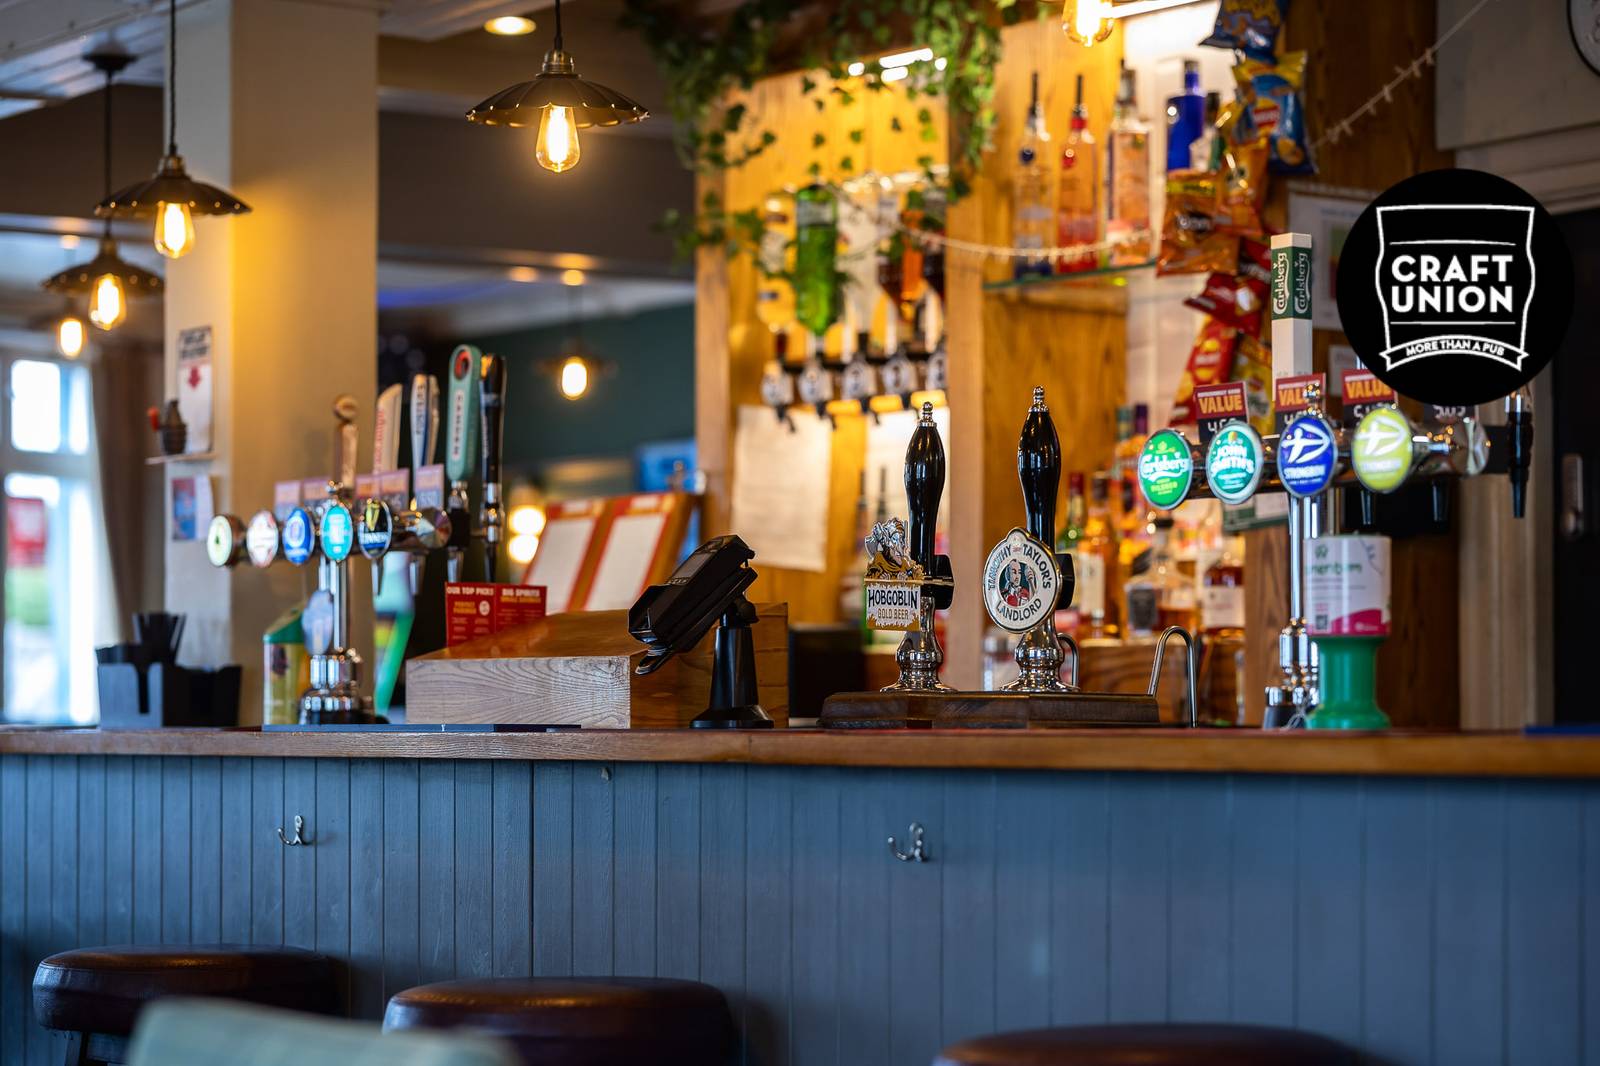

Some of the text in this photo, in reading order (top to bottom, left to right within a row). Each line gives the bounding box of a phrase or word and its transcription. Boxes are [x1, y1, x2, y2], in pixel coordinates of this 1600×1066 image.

[1273, 252, 1290, 314] Carlsberg
[1294, 252, 1310, 314] Carlsberg
[1199, 394, 1243, 414] VALUE
[1140, 452, 1192, 482] Carlsberg
[1022, 543, 1052, 589] TAYLOR'S
[867, 589, 918, 610] HOBGOBLIN
[996, 598, 1043, 621] LANDLORD
[878, 608, 909, 620] GOLD BEER
